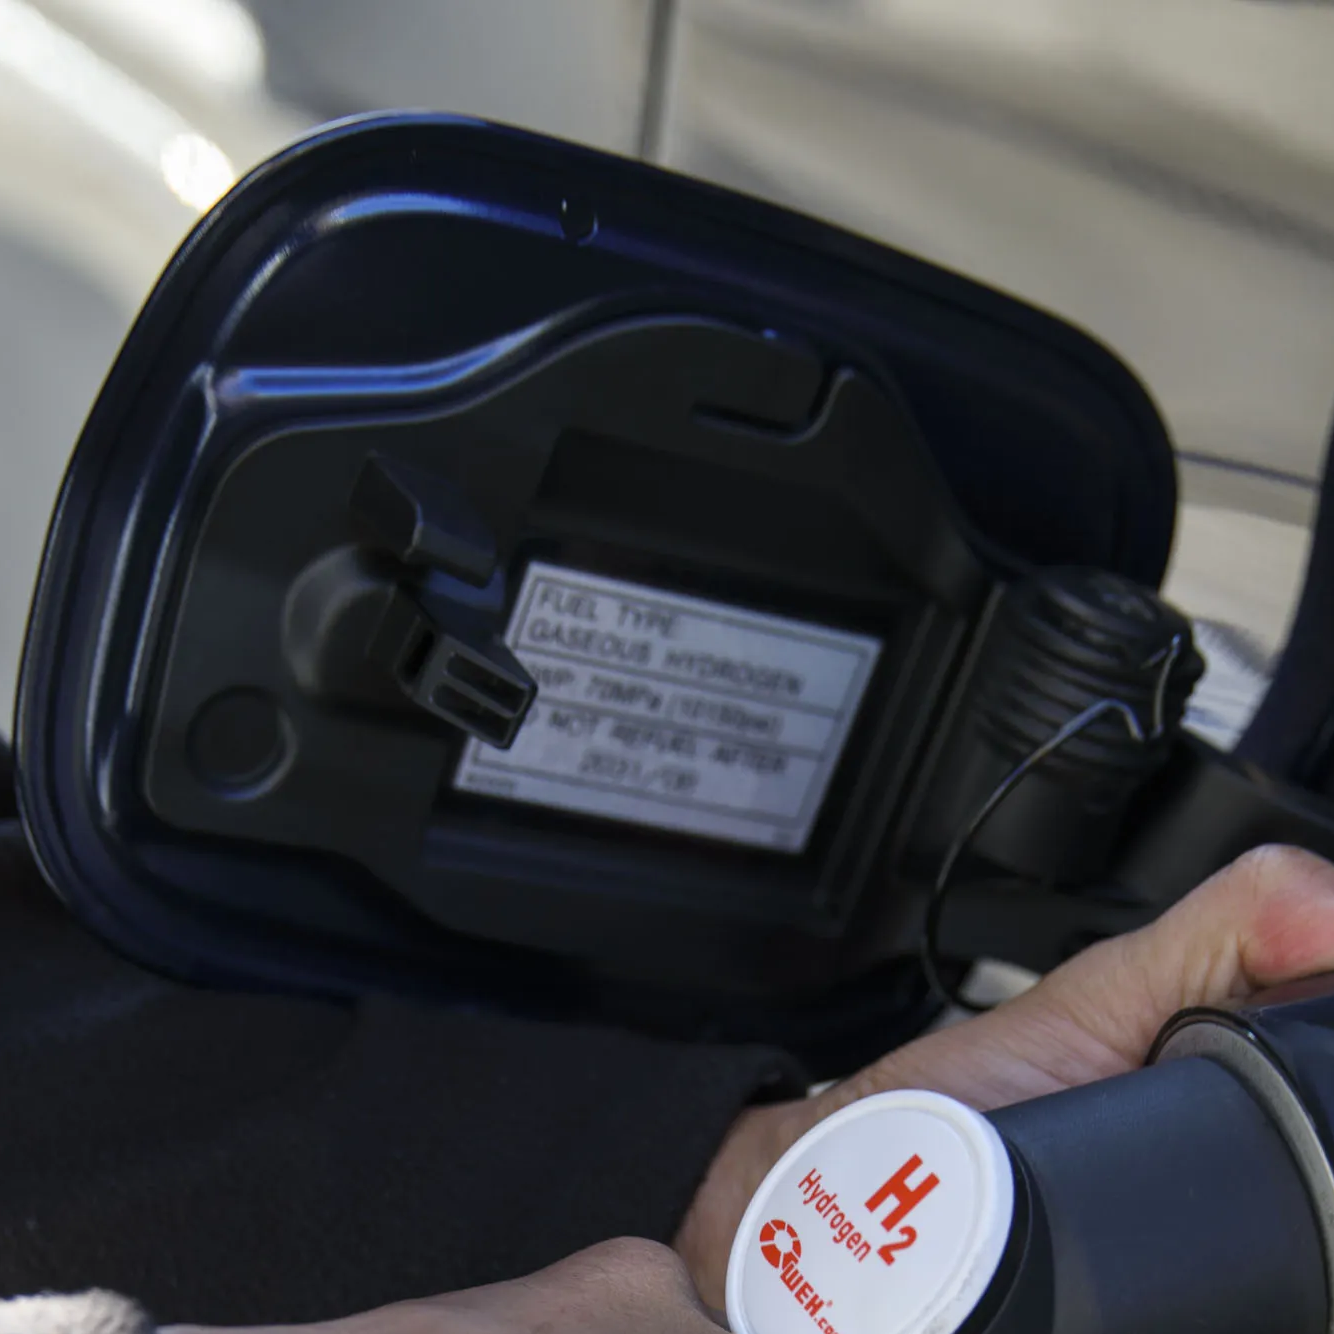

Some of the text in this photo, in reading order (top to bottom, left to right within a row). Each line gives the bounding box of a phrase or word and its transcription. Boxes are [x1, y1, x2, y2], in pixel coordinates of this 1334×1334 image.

[537, 584, 678, 640] FUEL TYPE
[527, 617, 805, 697] GASEOUS HYDROGEN
[548, 710, 601, 740] NOT
[798, 1168, 871, 1261] Hydrogen
